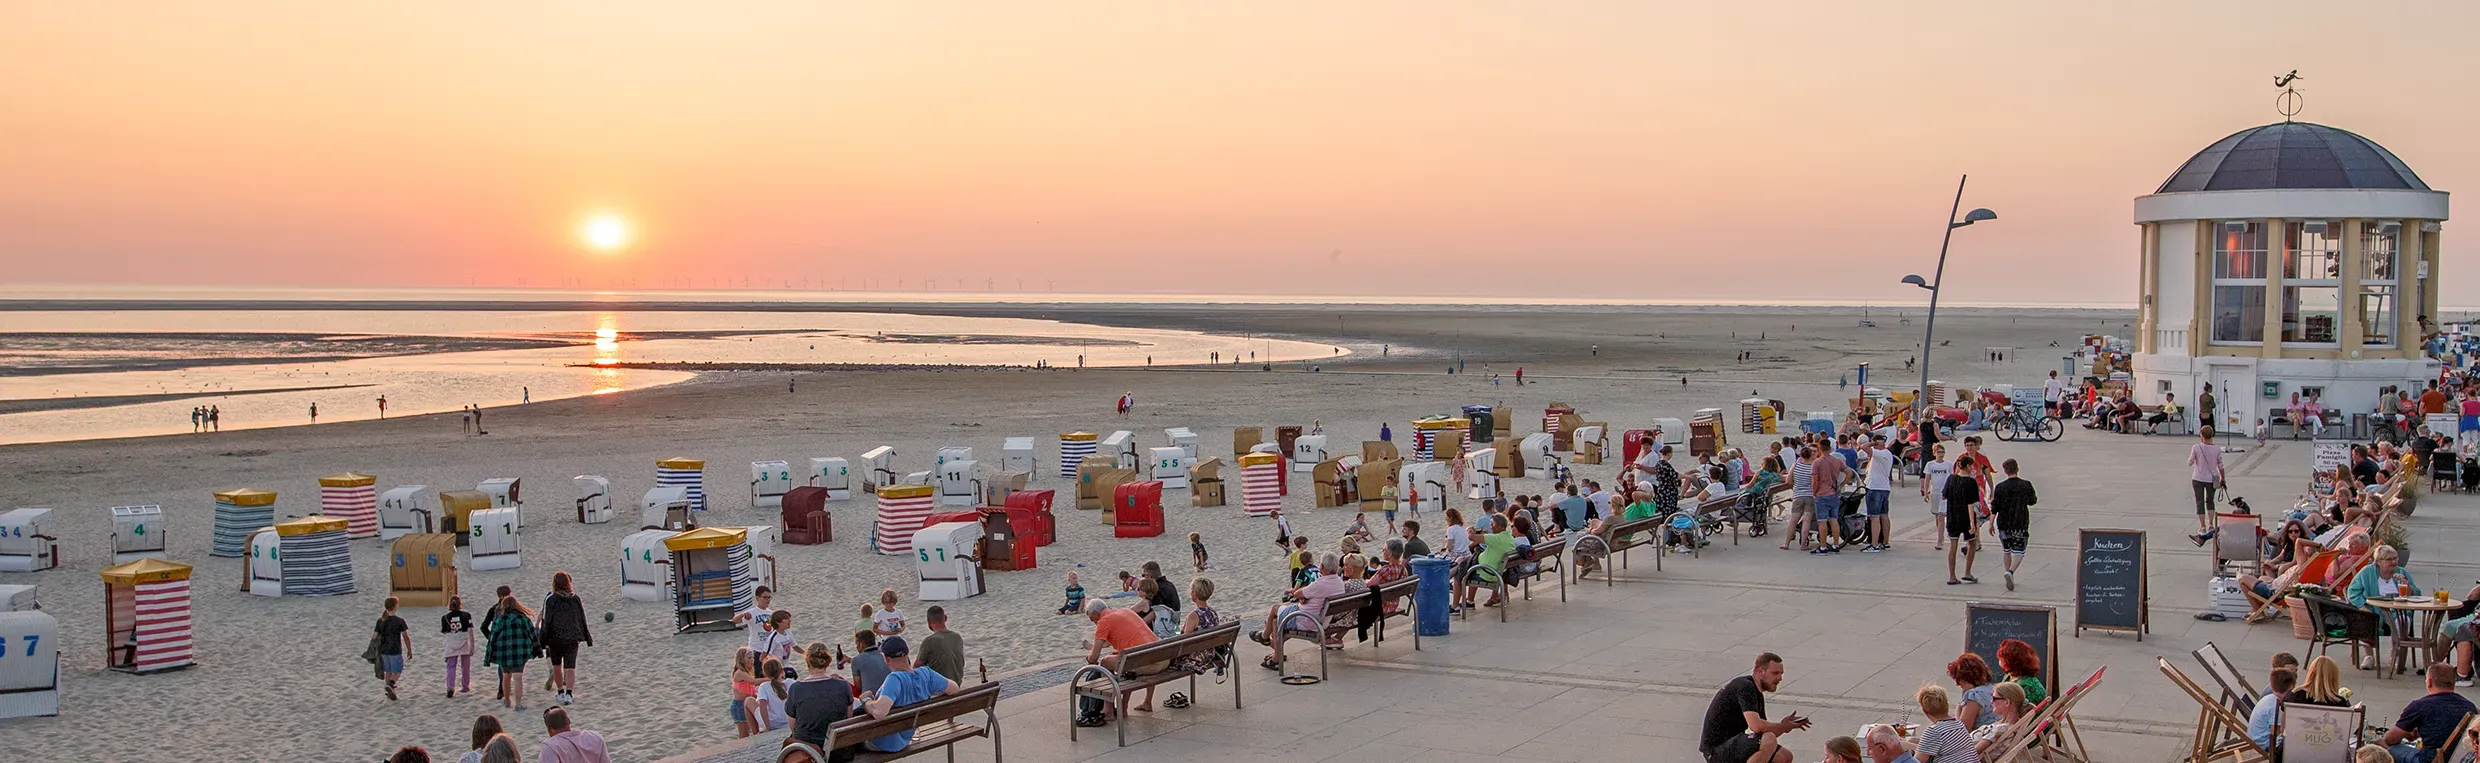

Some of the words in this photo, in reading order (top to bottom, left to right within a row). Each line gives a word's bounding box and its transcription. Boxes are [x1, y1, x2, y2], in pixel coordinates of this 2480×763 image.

[947, 471, 960, 481] 11
[1408, 472, 1415, 483] 9
[134, 524, 145, 536] 4
[2094, 537, 2124, 549] Kuchen
